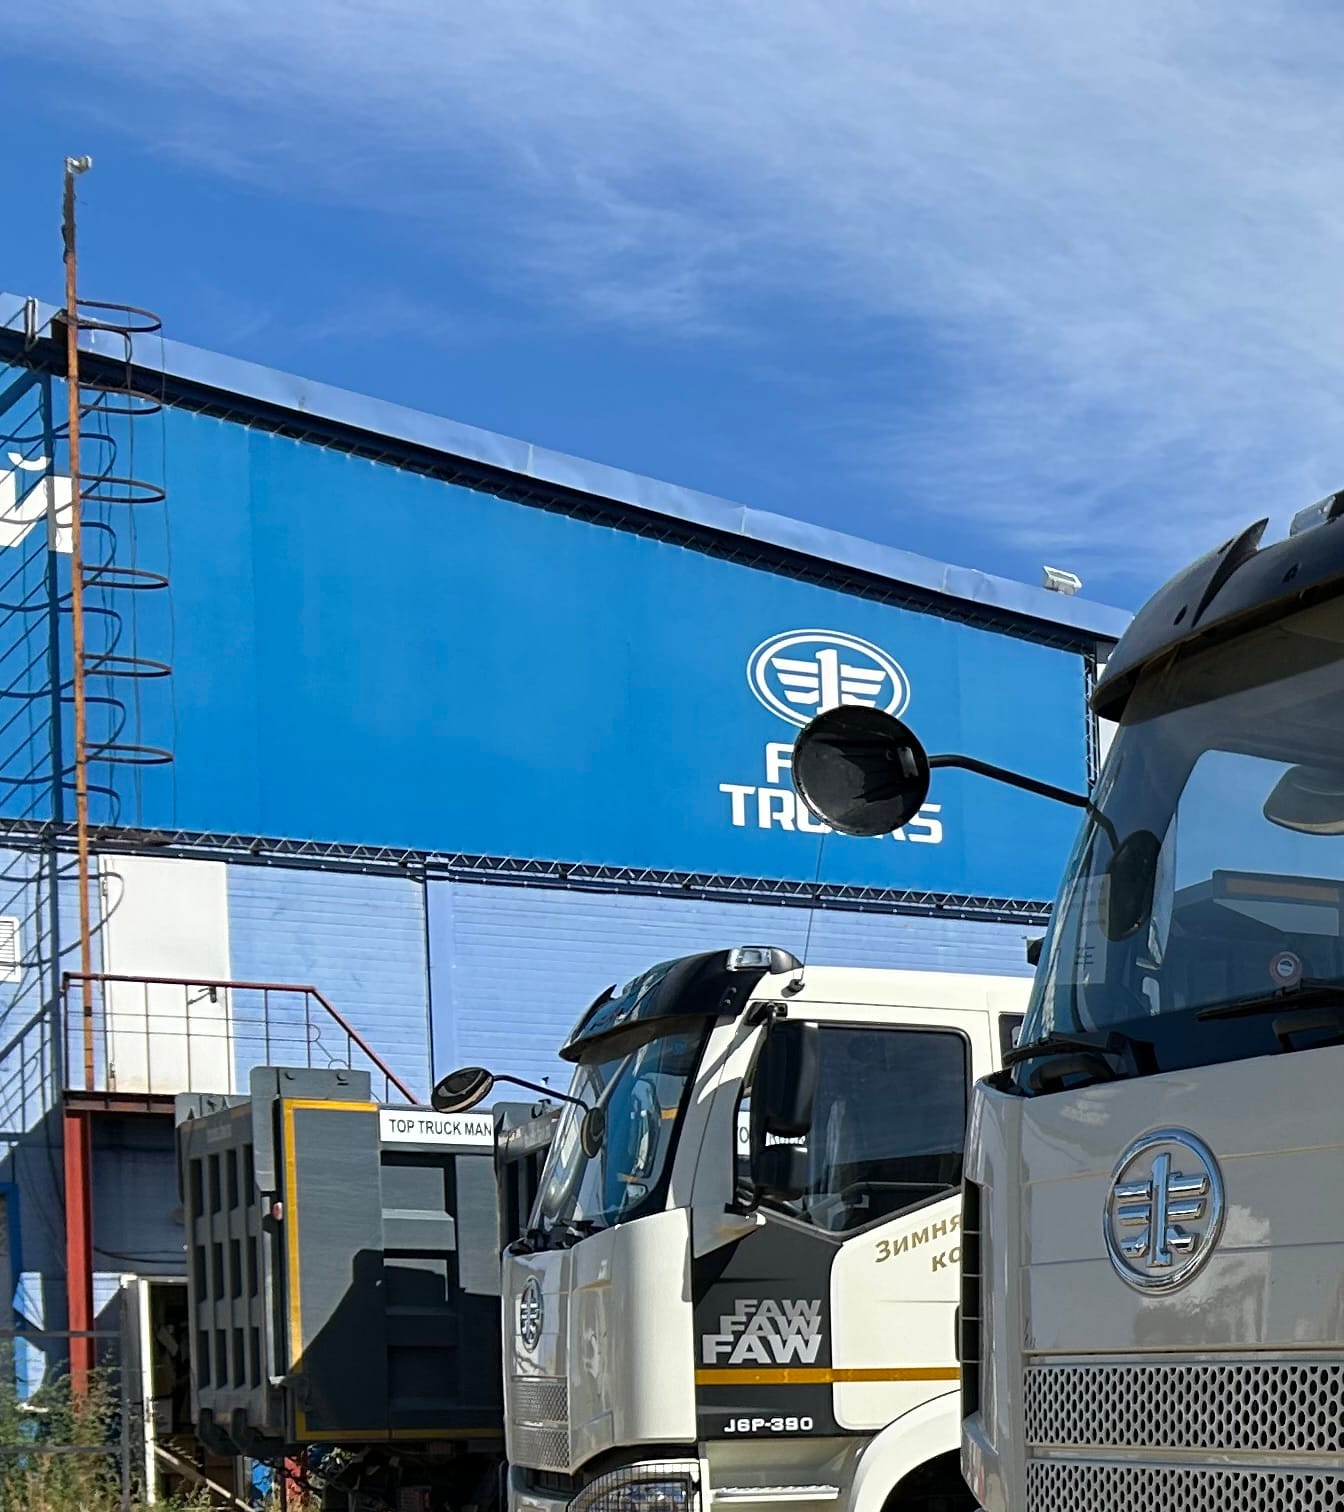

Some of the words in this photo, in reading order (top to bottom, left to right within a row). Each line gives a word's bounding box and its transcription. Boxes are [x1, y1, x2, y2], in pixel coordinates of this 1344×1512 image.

[719, 783, 943, 844] TRUS
[389, 1119, 415, 1134] TOP
[418, 1120, 462, 1136] TRUCK
[734, 1299, 822, 1322] FAW
[719, 1315, 822, 1341] FAW
[702, 1333, 823, 1364] FAW
